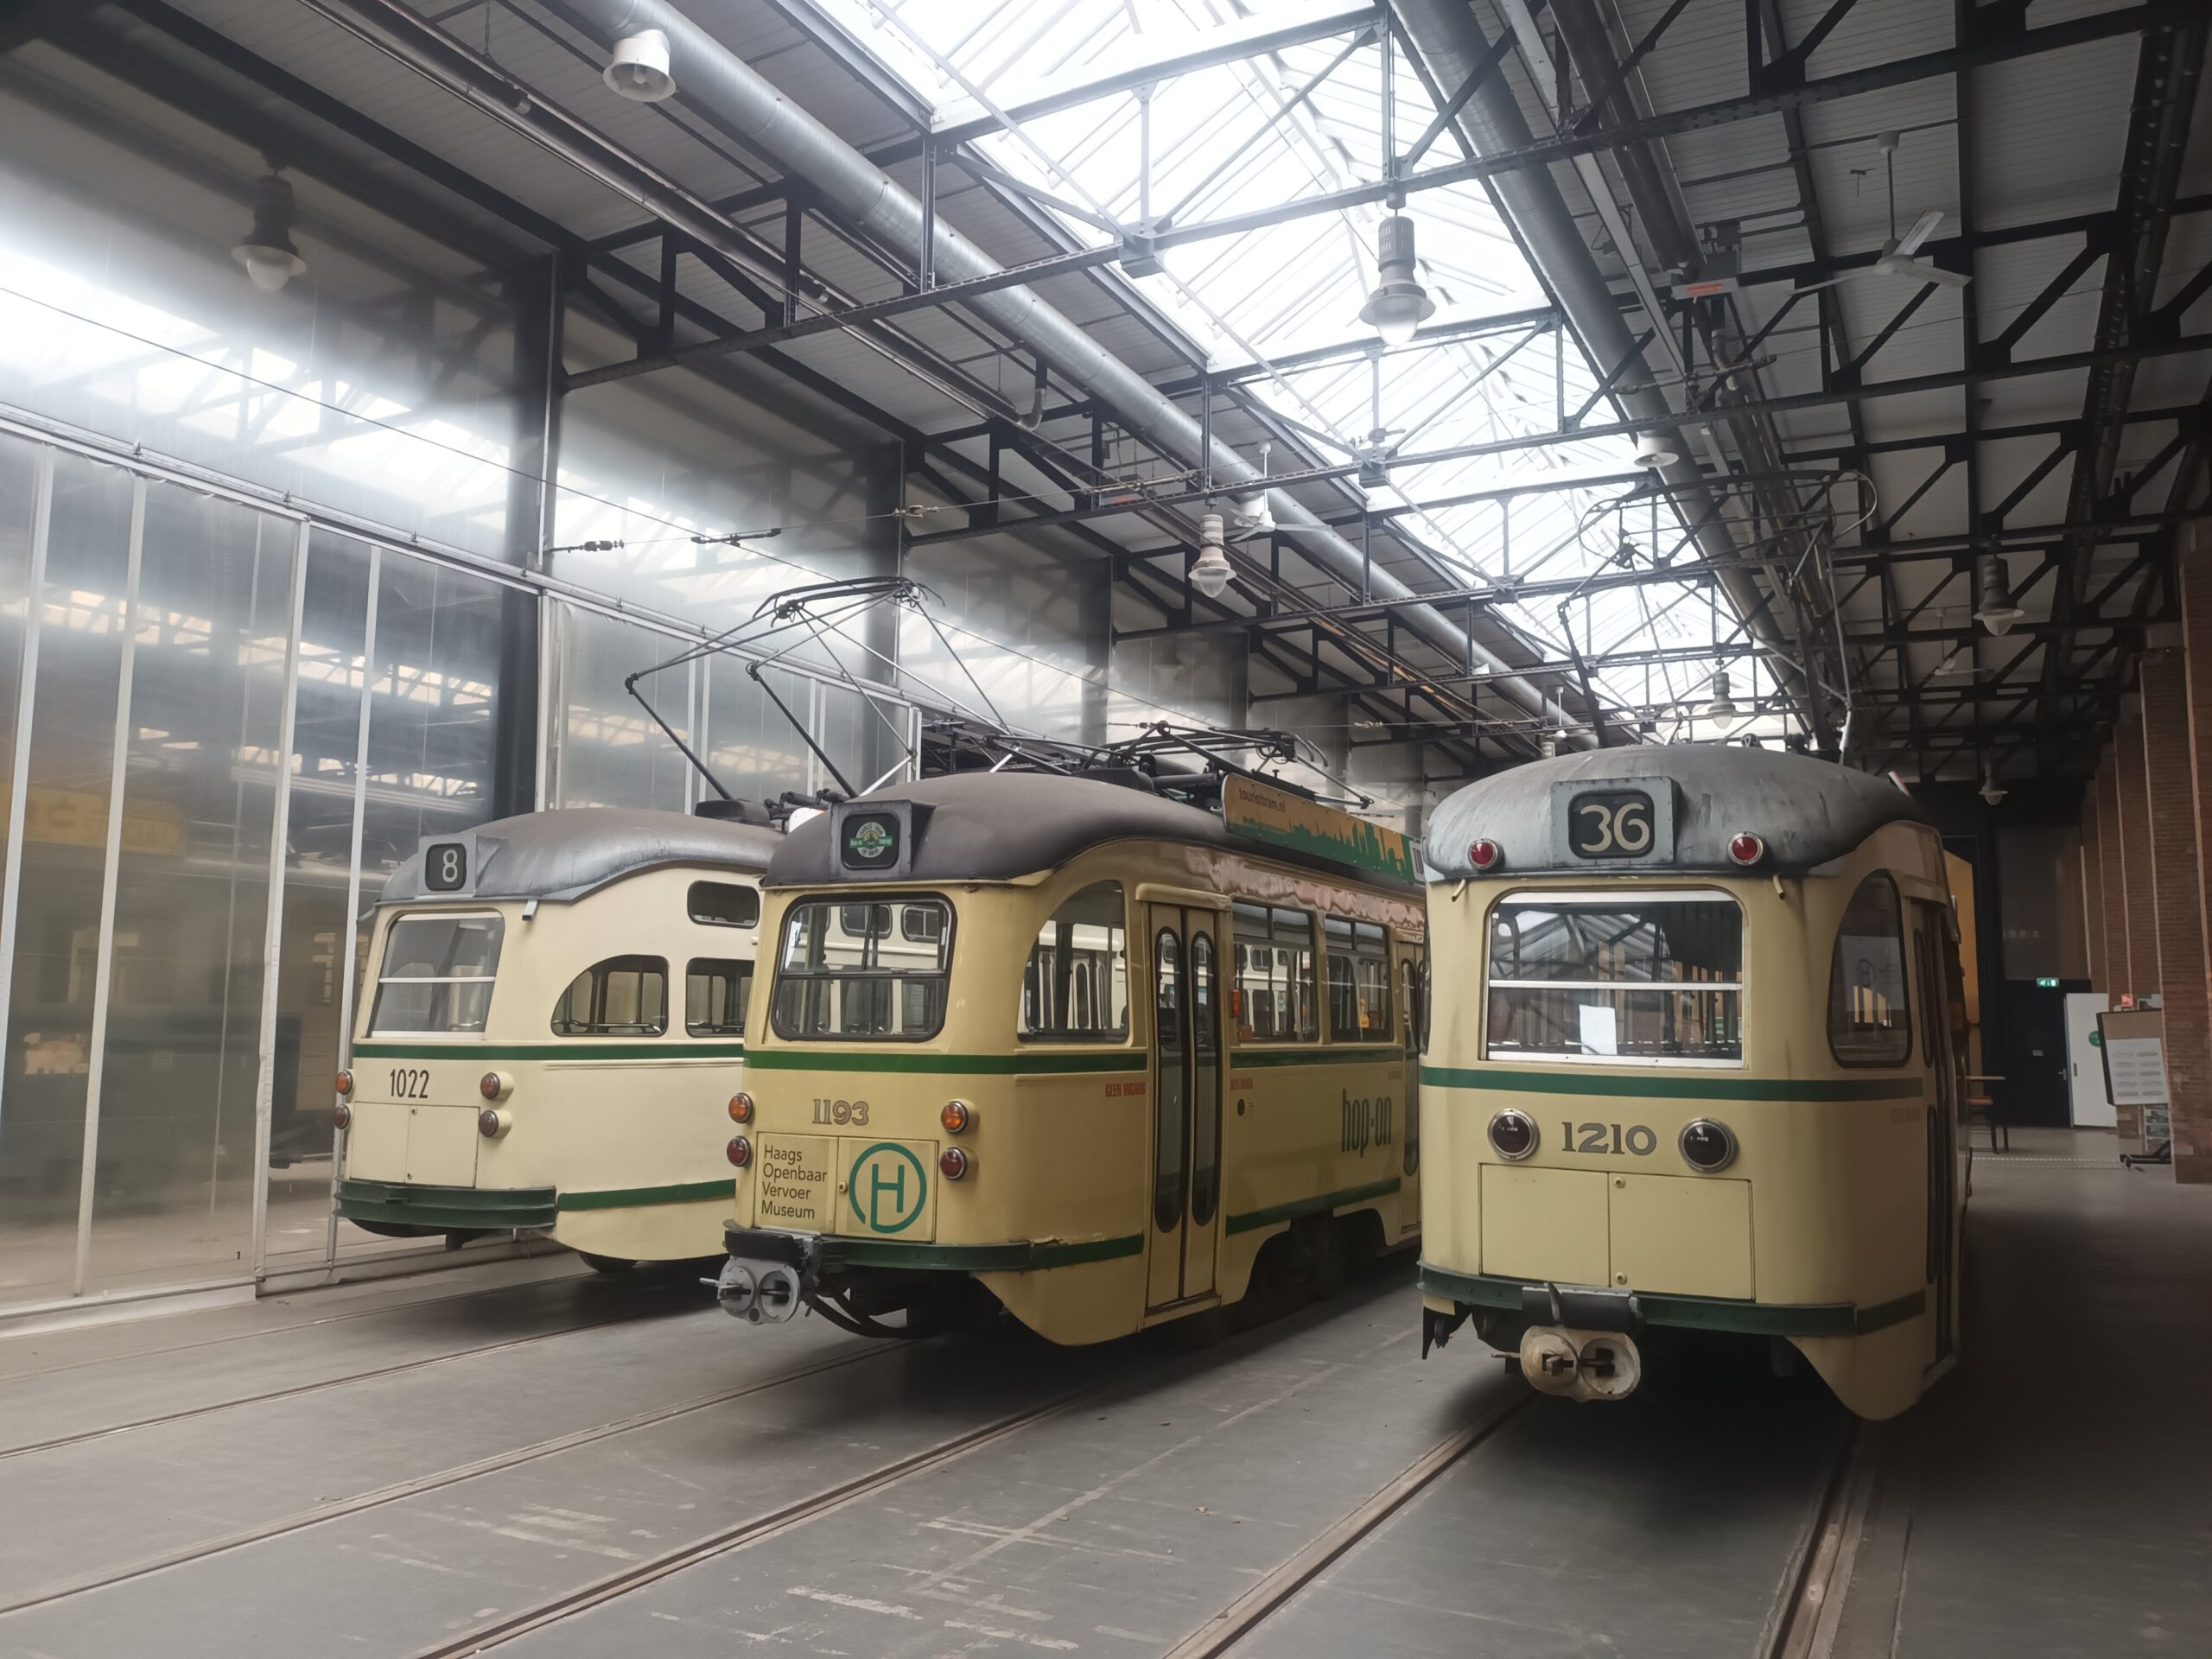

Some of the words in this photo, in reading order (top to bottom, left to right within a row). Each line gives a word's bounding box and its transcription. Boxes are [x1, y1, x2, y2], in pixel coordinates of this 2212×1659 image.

[1238, 787, 1287, 813] touristtram.nl
[1580, 802, 1650, 853] 36
[442, 849, 458, 883] 8
[390, 1069, 430, 1099] 1022
[812, 1098, 869, 1126] 1193
[1341, 1088, 1392, 1159] hop-on
[1561, 1121, 1657, 1156] 1210
[764, 1145, 803, 1165] Haags
[763, 1163, 828, 1183] Openbaar
[761, 1181, 810, 1199] Vervoer
[760, 1200, 815, 1219] Museum
